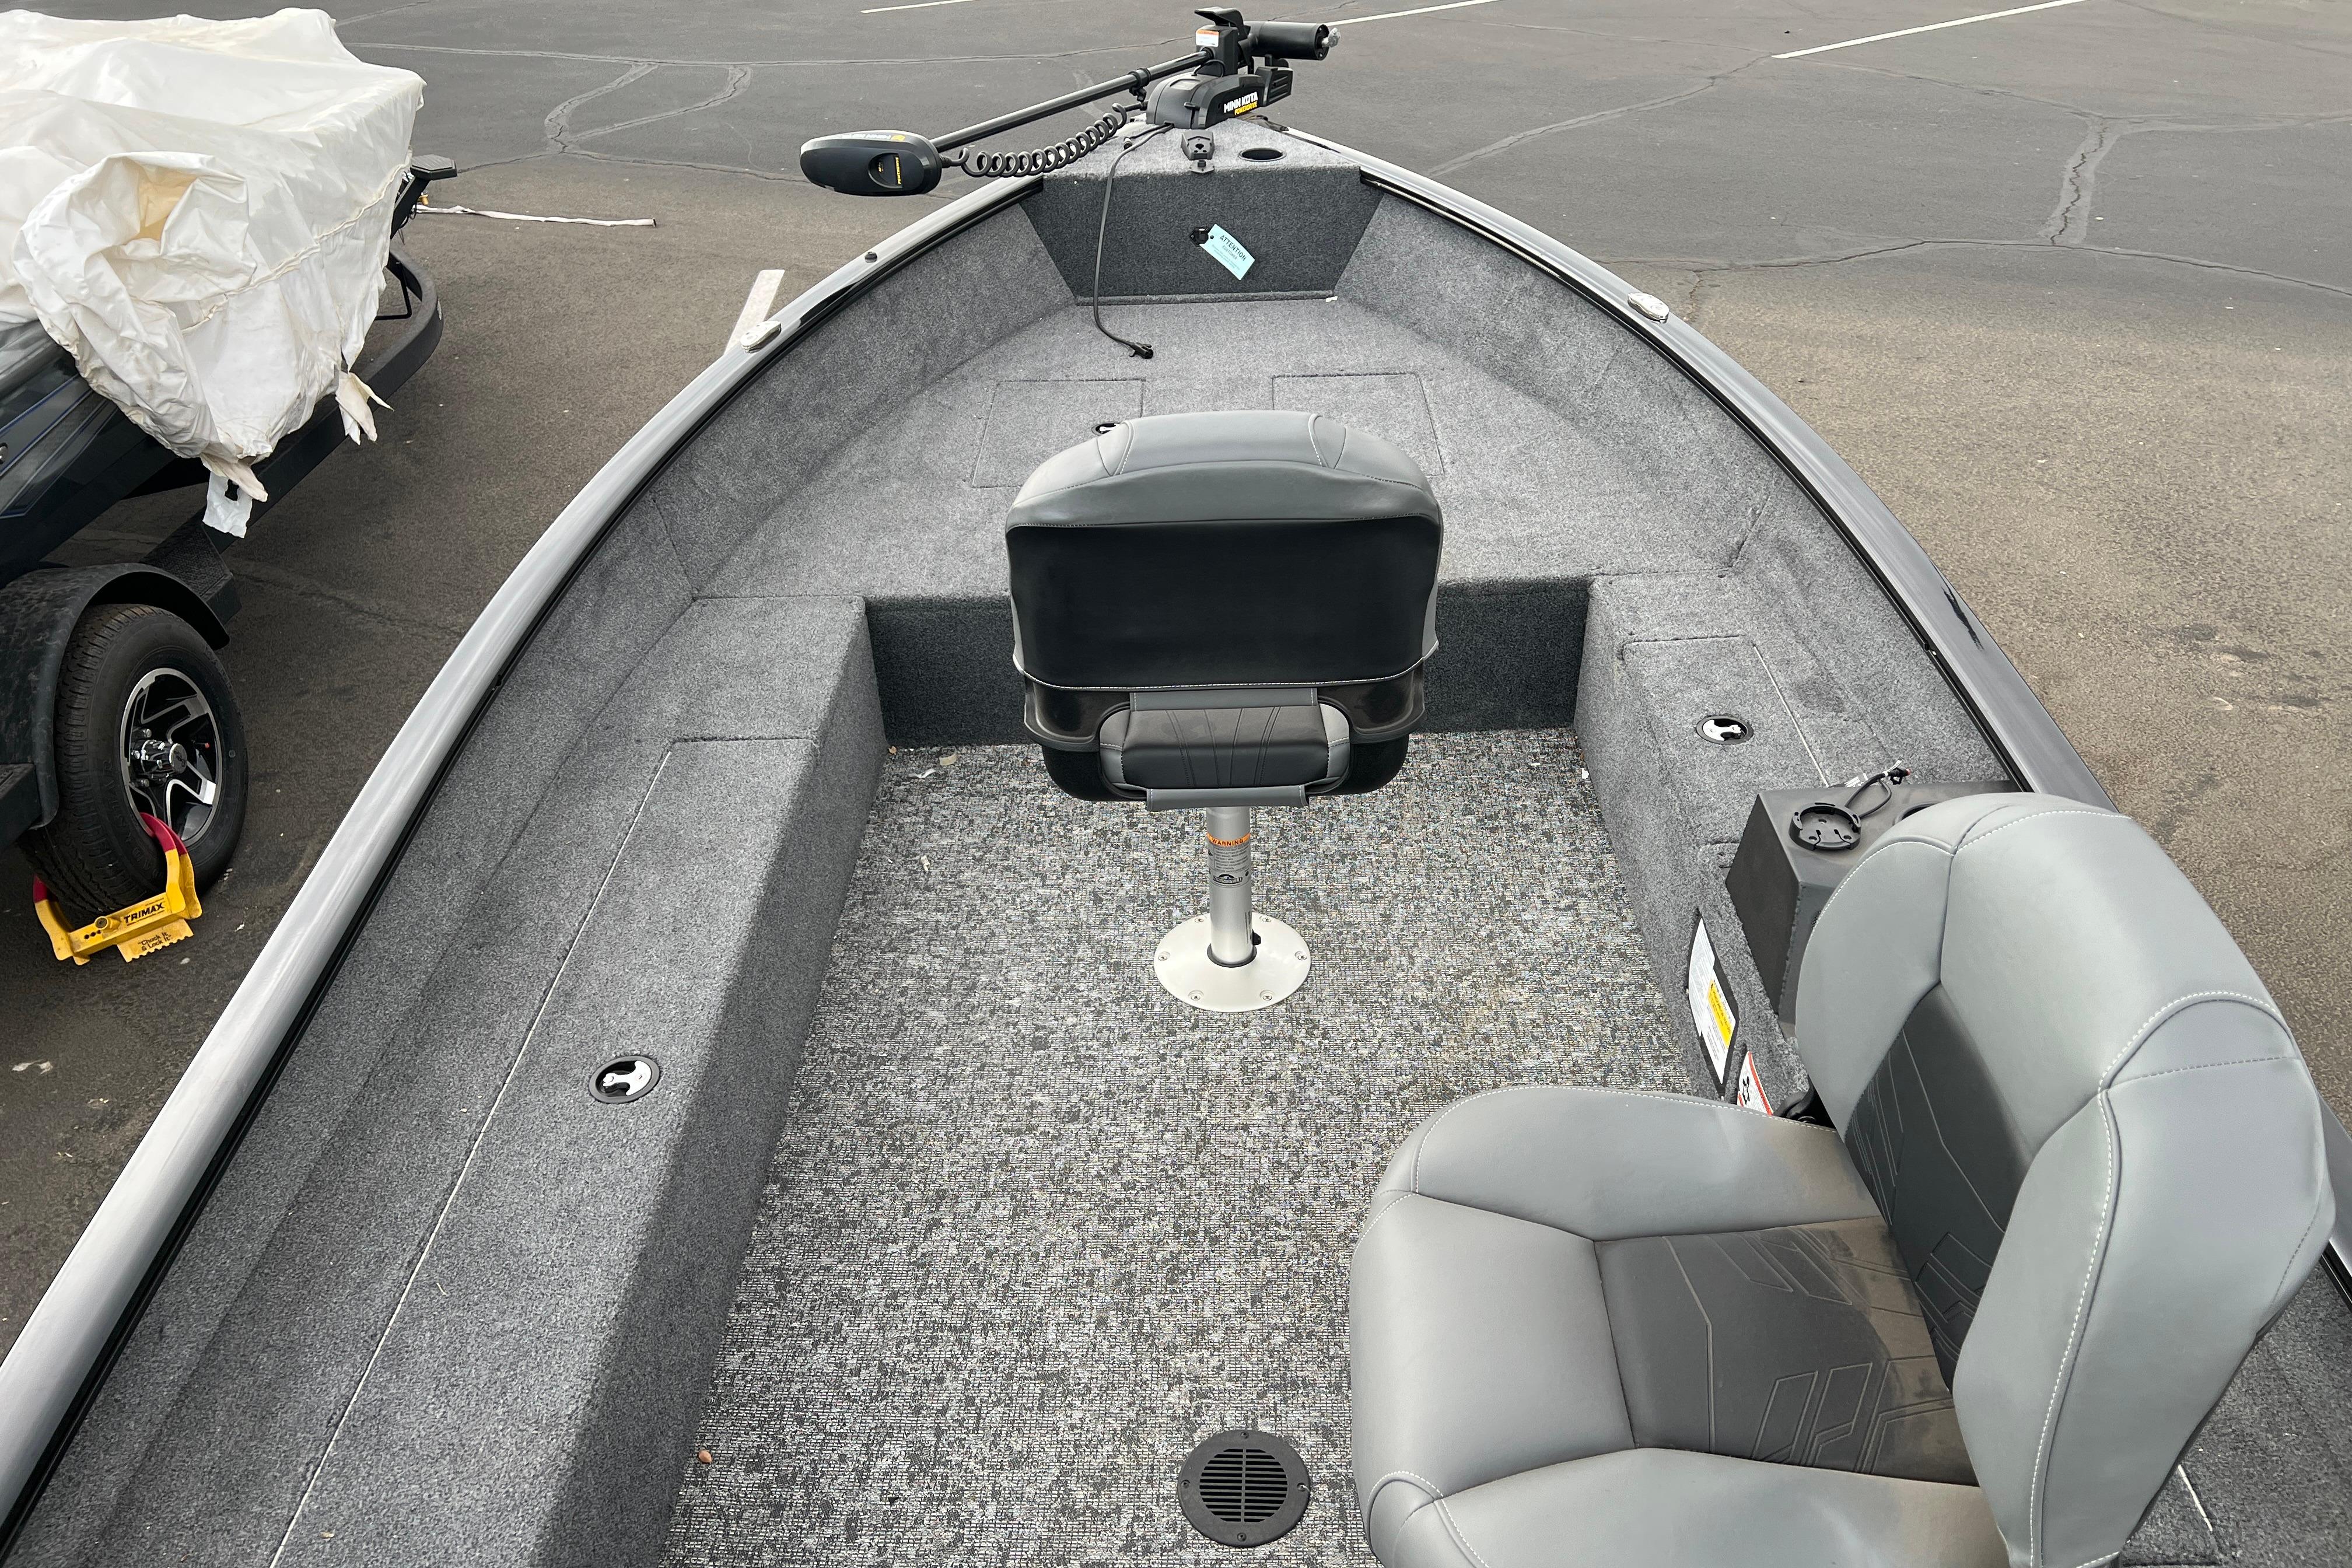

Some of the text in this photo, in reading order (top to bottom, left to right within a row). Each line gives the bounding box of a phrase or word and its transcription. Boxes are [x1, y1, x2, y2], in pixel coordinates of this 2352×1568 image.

[1224, 92, 1258, 113] MINN KOTA
[1220, 235, 1247, 261] ATTENTION
[1212, 838, 1244, 846] WARNING
[124, 902, 165, 923] TRIMAX
[148, 939, 164, 949] Lock
